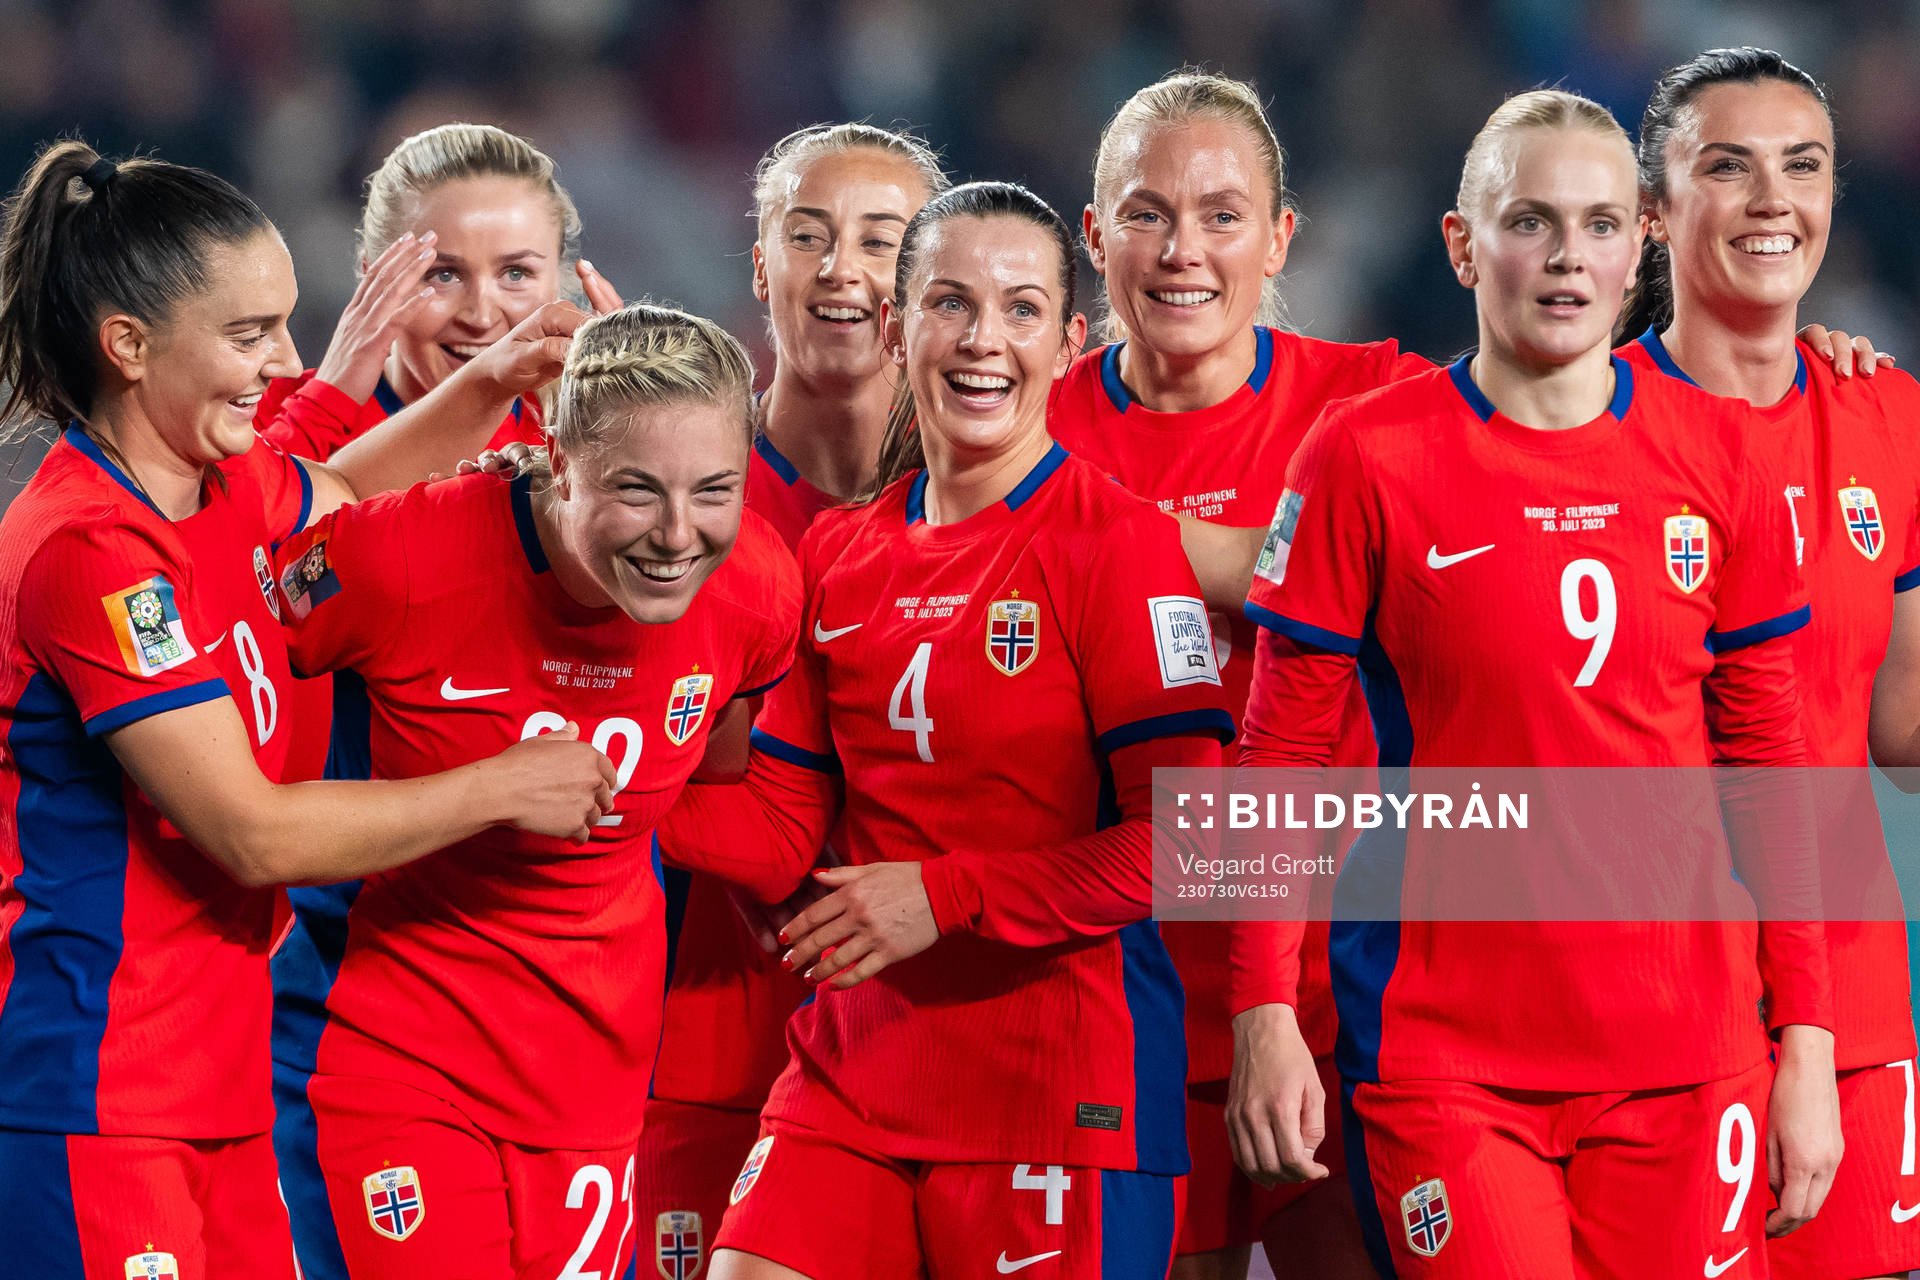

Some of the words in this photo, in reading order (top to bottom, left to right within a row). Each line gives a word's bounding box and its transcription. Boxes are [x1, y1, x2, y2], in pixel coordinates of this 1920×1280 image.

[1157, 499, 1175, 511] RGE
[1183, 488, 1238, 507] FILIPPINENE
[1200, 503, 1223, 518] 2023
[1524, 506, 1557, 519] NORGE
[1566, 503, 1620, 518] FILIPPINENE
[1542, 520, 1558, 532] 30.
[1560, 519, 1579, 532] JULI
[1582, 518, 1606, 531] 2023
[895, 597, 920, 608] NORGE
[926, 594, 970, 607] FILIPPINENE
[903, 608, 915, 619] 30.
[917, 608, 933, 619] JULI
[933, 607, 954, 618] 2023
[1171, 621, 1205, 639] UNITES
[1560, 558, 1617, 687] 9
[1171, 640, 1189, 654] the
[543, 659, 573, 674] NORGE
[580, 664, 635, 678] FILIPPINENE
[233, 620, 278, 746] 8
[556, 675, 570, 686] 30.
[572, 676, 589, 688] JULI
[592, 677, 616, 689] 2023
[888, 642, 935, 763] 4
[1717, 1102, 1756, 1233] 9
